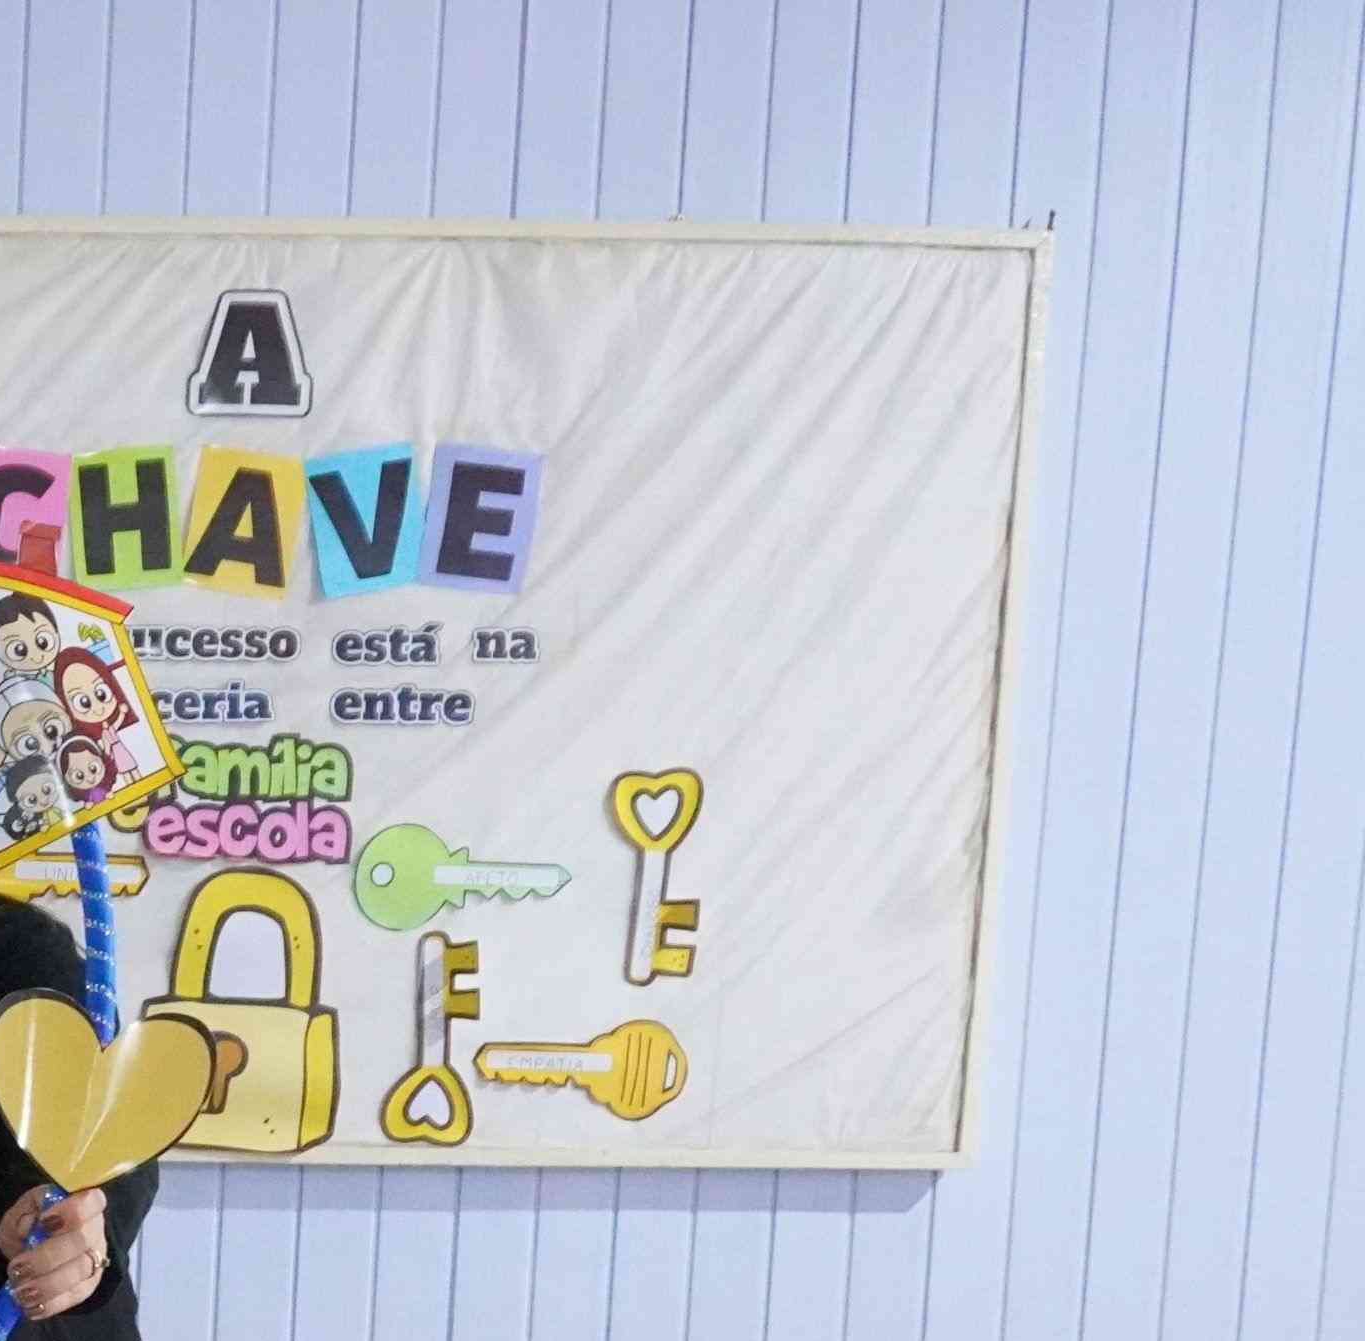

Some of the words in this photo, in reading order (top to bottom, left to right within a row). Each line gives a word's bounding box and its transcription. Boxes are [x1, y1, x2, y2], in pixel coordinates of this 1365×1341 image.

[191, 294, 308, 412] A
[130, 627, 299, 658] ucesso
[334, 623, 441, 664] está
[475, 630, 537, 660] na
[151, 682, 273, 719] ceria
[332, 686, 473, 723] entre
[143, 801, 350, 862] escola
